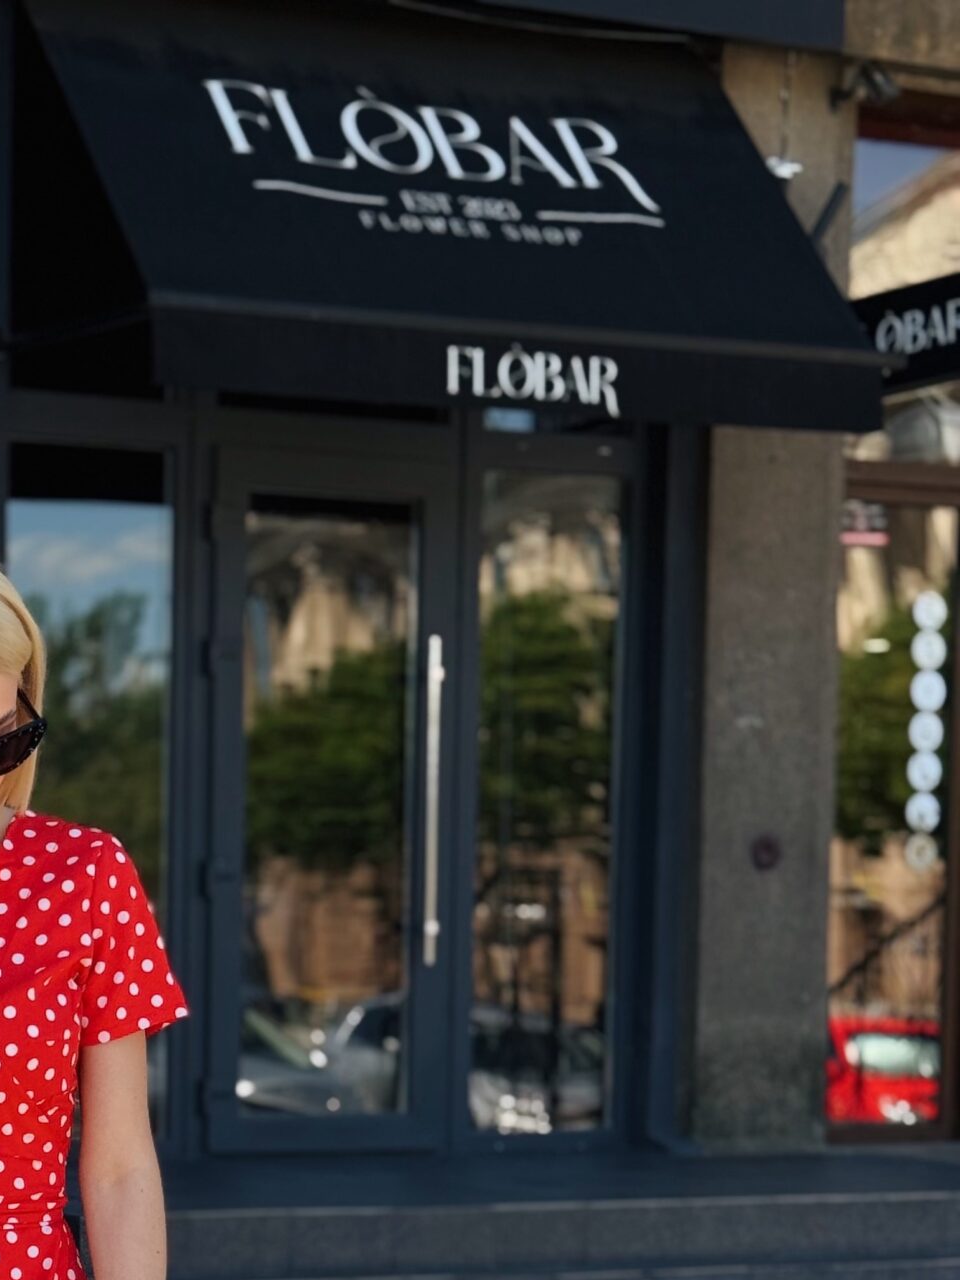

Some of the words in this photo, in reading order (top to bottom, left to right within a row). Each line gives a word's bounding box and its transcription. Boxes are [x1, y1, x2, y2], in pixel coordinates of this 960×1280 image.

[399, 189, 453, 215] EST
[358, 209, 490, 239] FLOWER
[500, 223, 583, 246] SHOP
